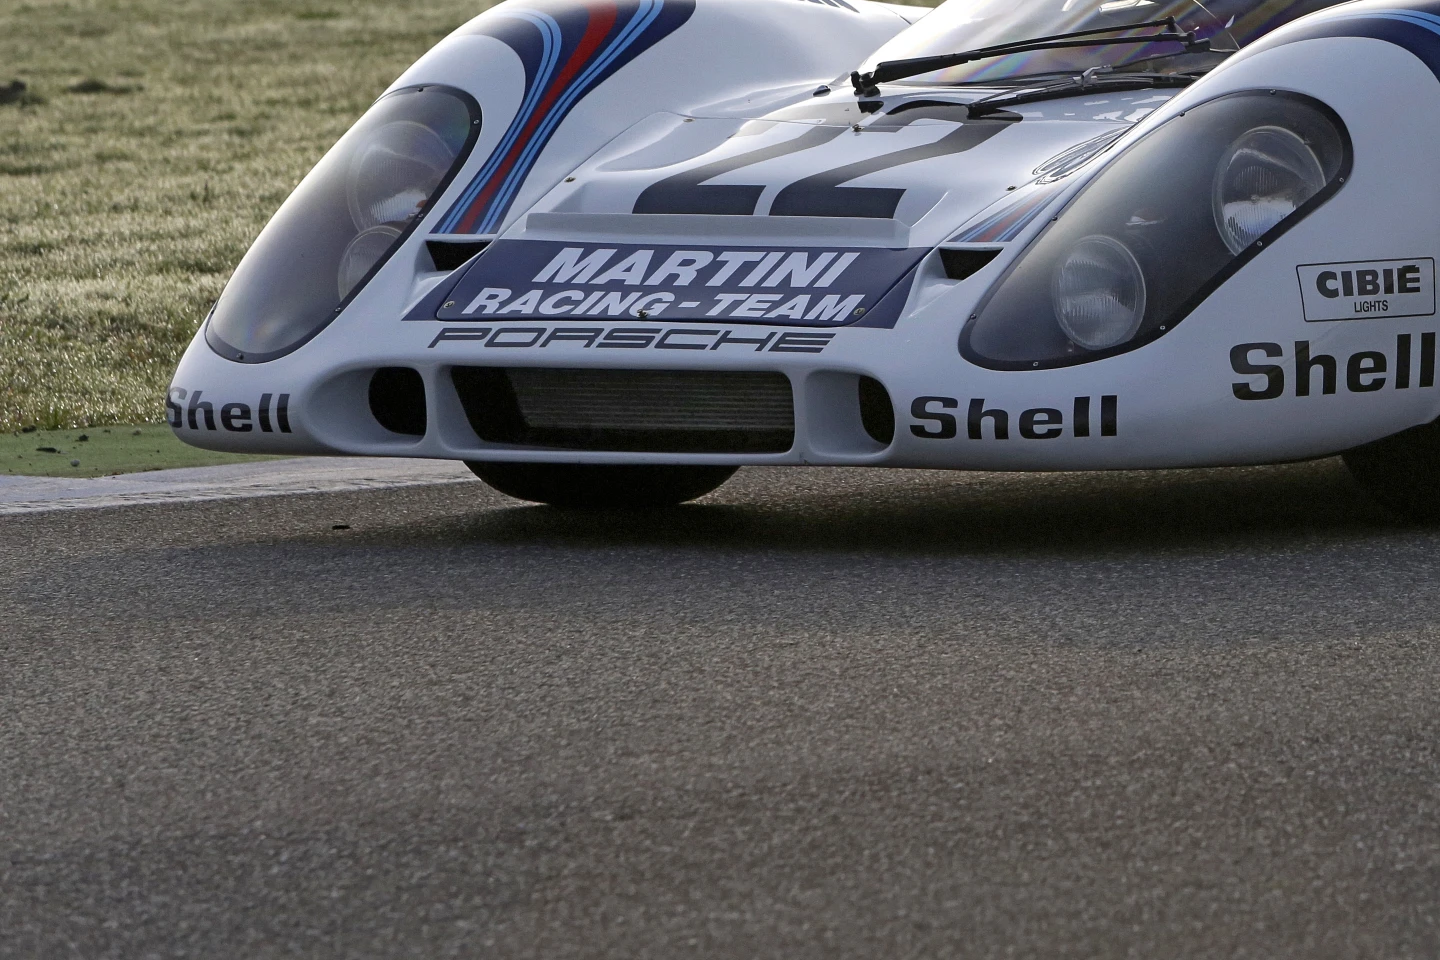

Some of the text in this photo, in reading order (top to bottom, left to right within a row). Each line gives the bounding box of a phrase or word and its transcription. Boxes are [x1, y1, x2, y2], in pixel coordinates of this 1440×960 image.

[631, 99, 1025, 219] 22
[531, 246, 861, 289] MARTINI
[1353, 300, 1389, 313] LIGHTS
[427, 327, 837, 354] PORSCHE
[1228, 331, 1437, 401] Shell
[166, 386, 293, 434] Shell
[909, 394, 1119, 440] Shell
